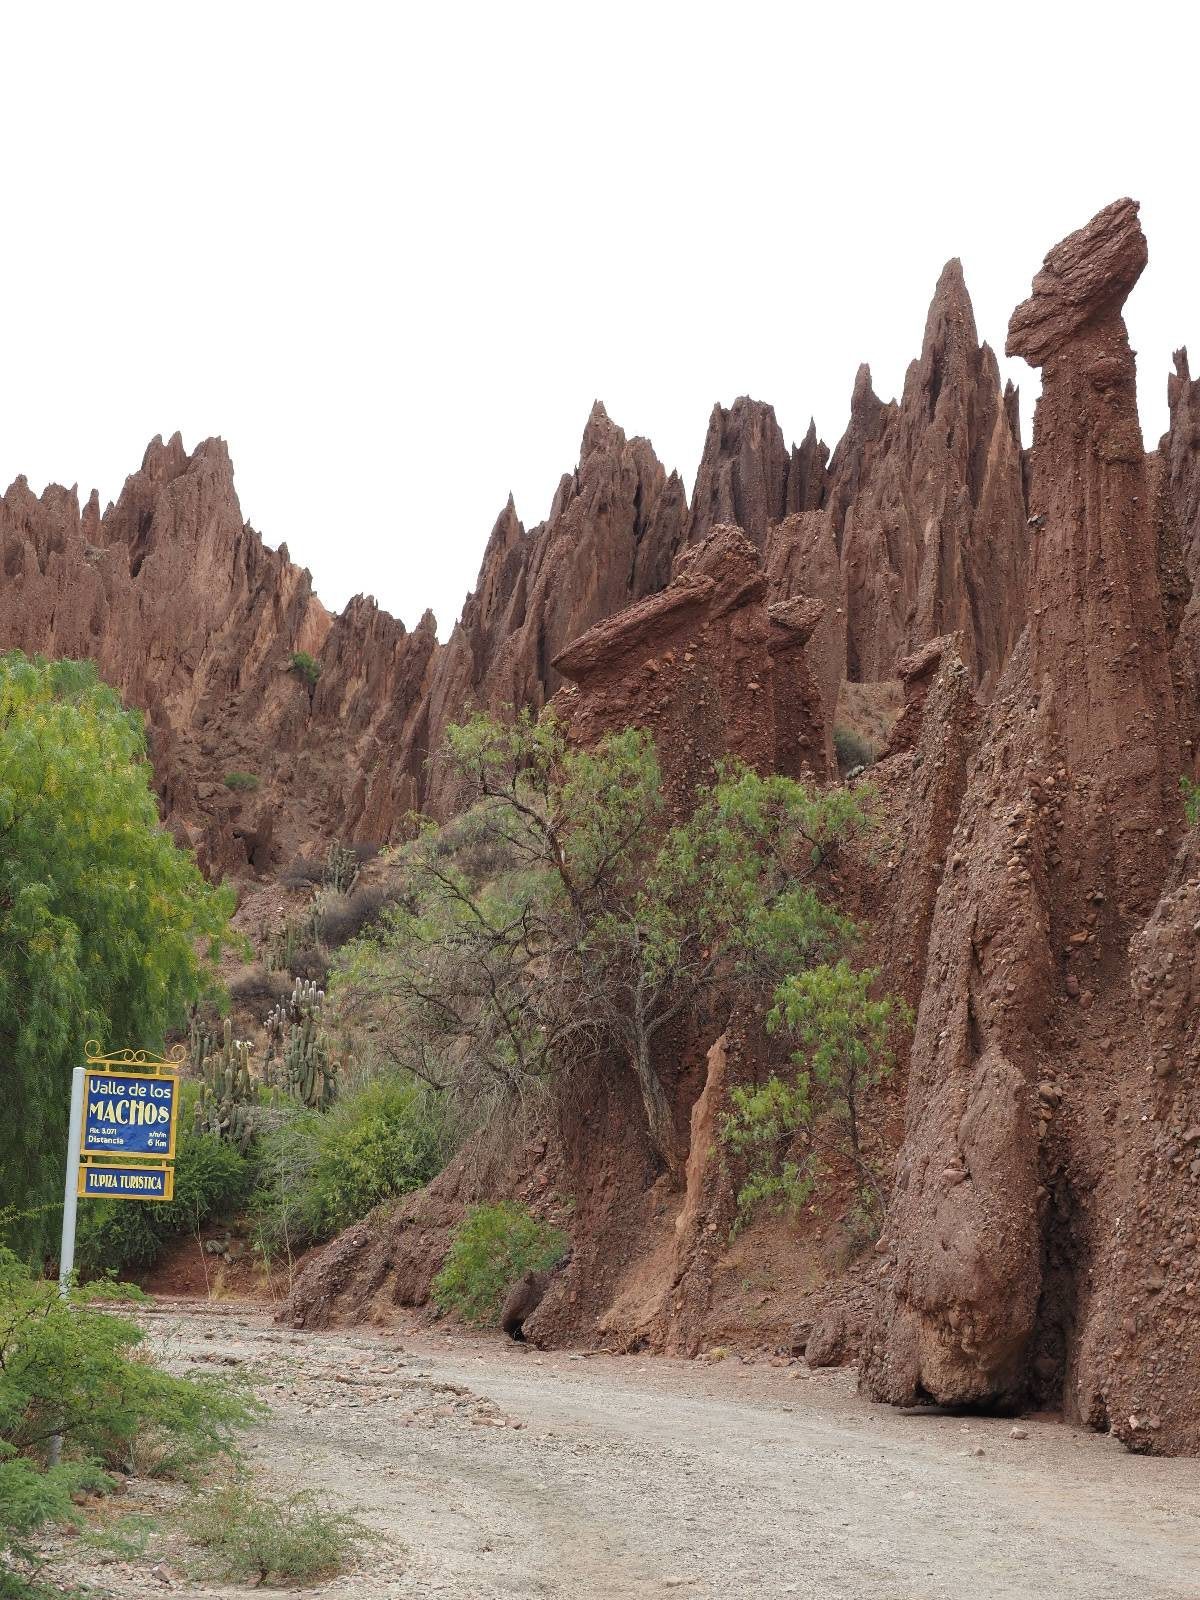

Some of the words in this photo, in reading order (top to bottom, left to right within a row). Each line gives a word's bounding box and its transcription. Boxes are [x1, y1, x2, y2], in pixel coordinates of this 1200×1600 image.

[90, 1079, 126, 1095] Valle
[128, 1082, 147, 1097] de
[150, 1083, 171, 1099] los
[89, 1099, 170, 1125] MACHOS
[88, 1135, 124, 1145] Distancia
[155, 1139, 167, 1147] Km
[89, 1173, 118, 1188] TUPIZA
[119, 1175, 162, 1190] TURISTICA
